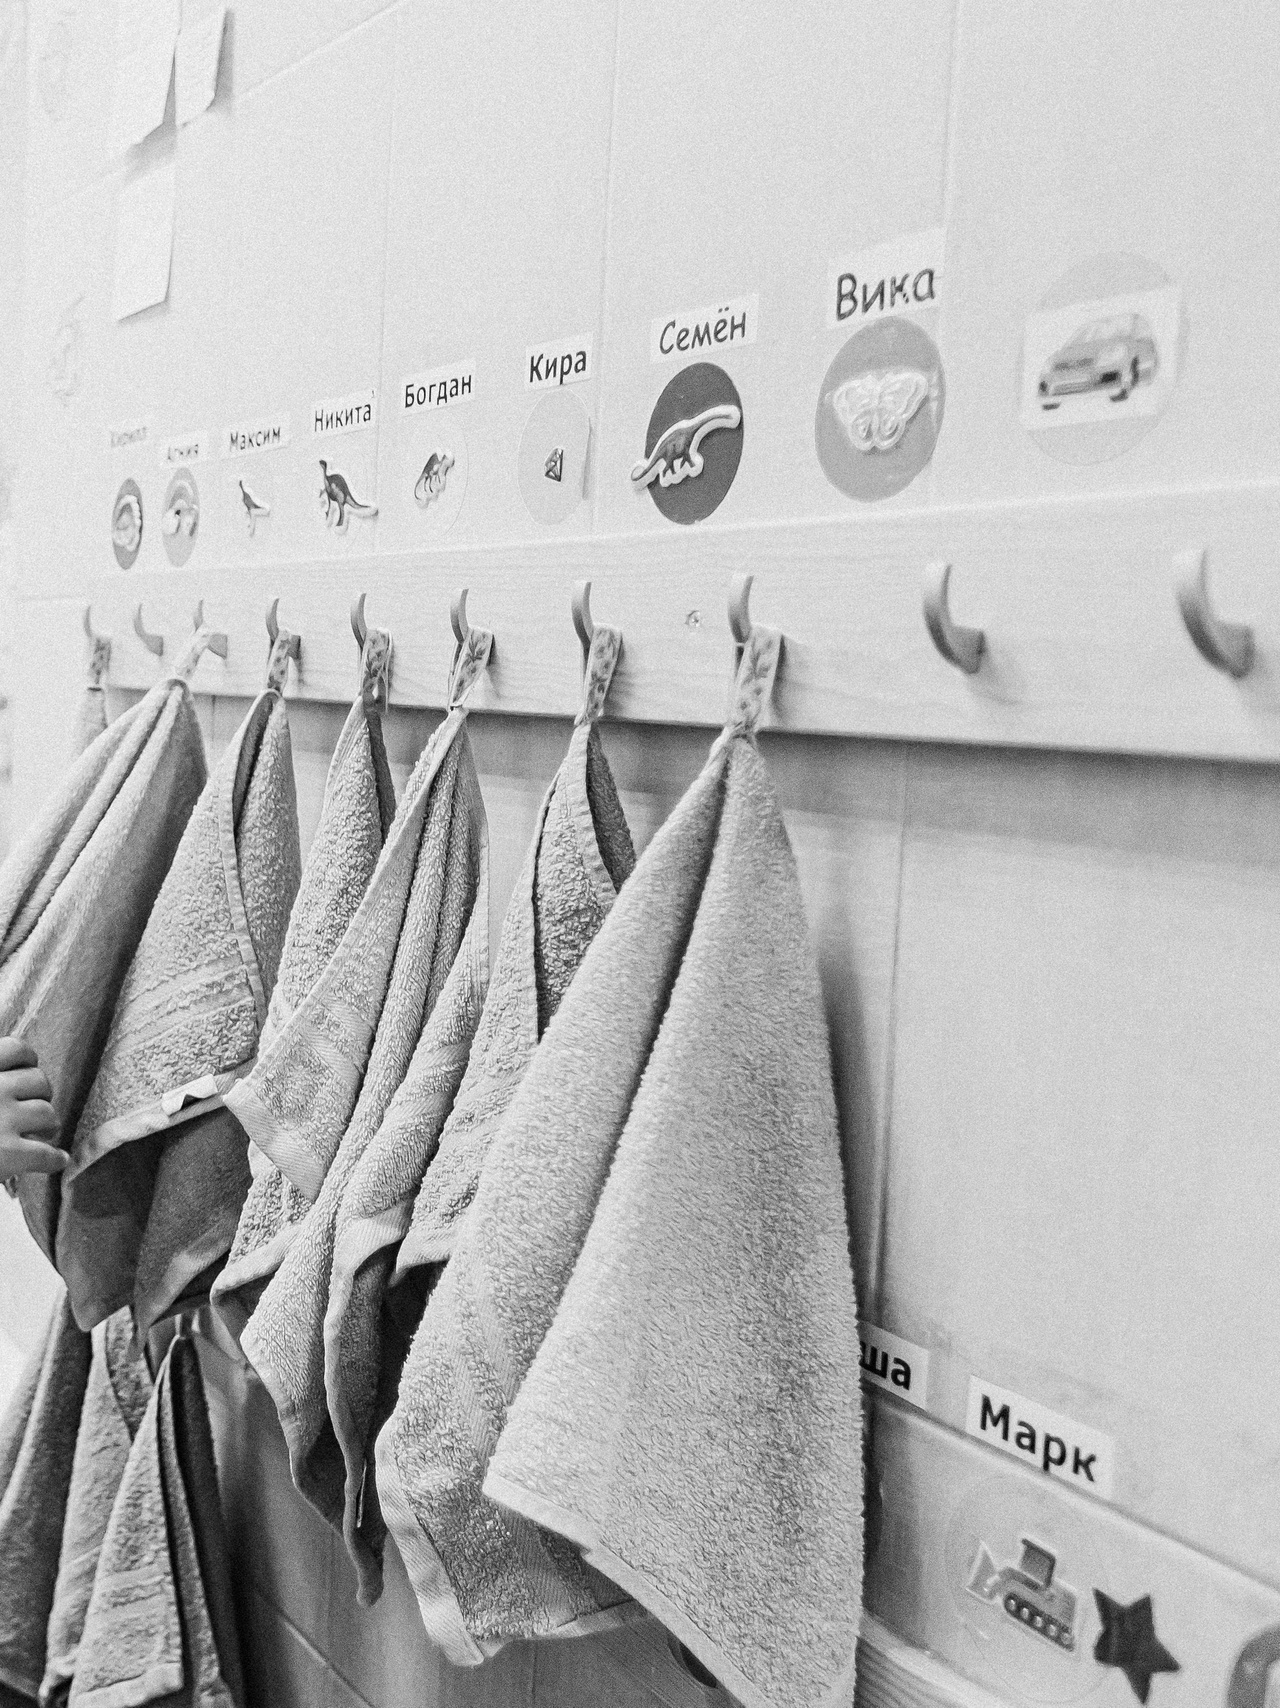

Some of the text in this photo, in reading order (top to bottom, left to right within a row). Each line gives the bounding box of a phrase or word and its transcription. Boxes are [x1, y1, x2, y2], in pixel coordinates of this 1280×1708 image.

[835, 267, 936, 321] Вика
[658, 306, 747, 355] Семён
[529, 350, 587, 386] Кира
[404, 374, 473, 409] Богдан
[229, 426, 281, 451] Максим
[314, 403, 372, 432] Никита
[859, 1340, 911, 1391] ша
[979, 1394, 1097, 1483] Марк
